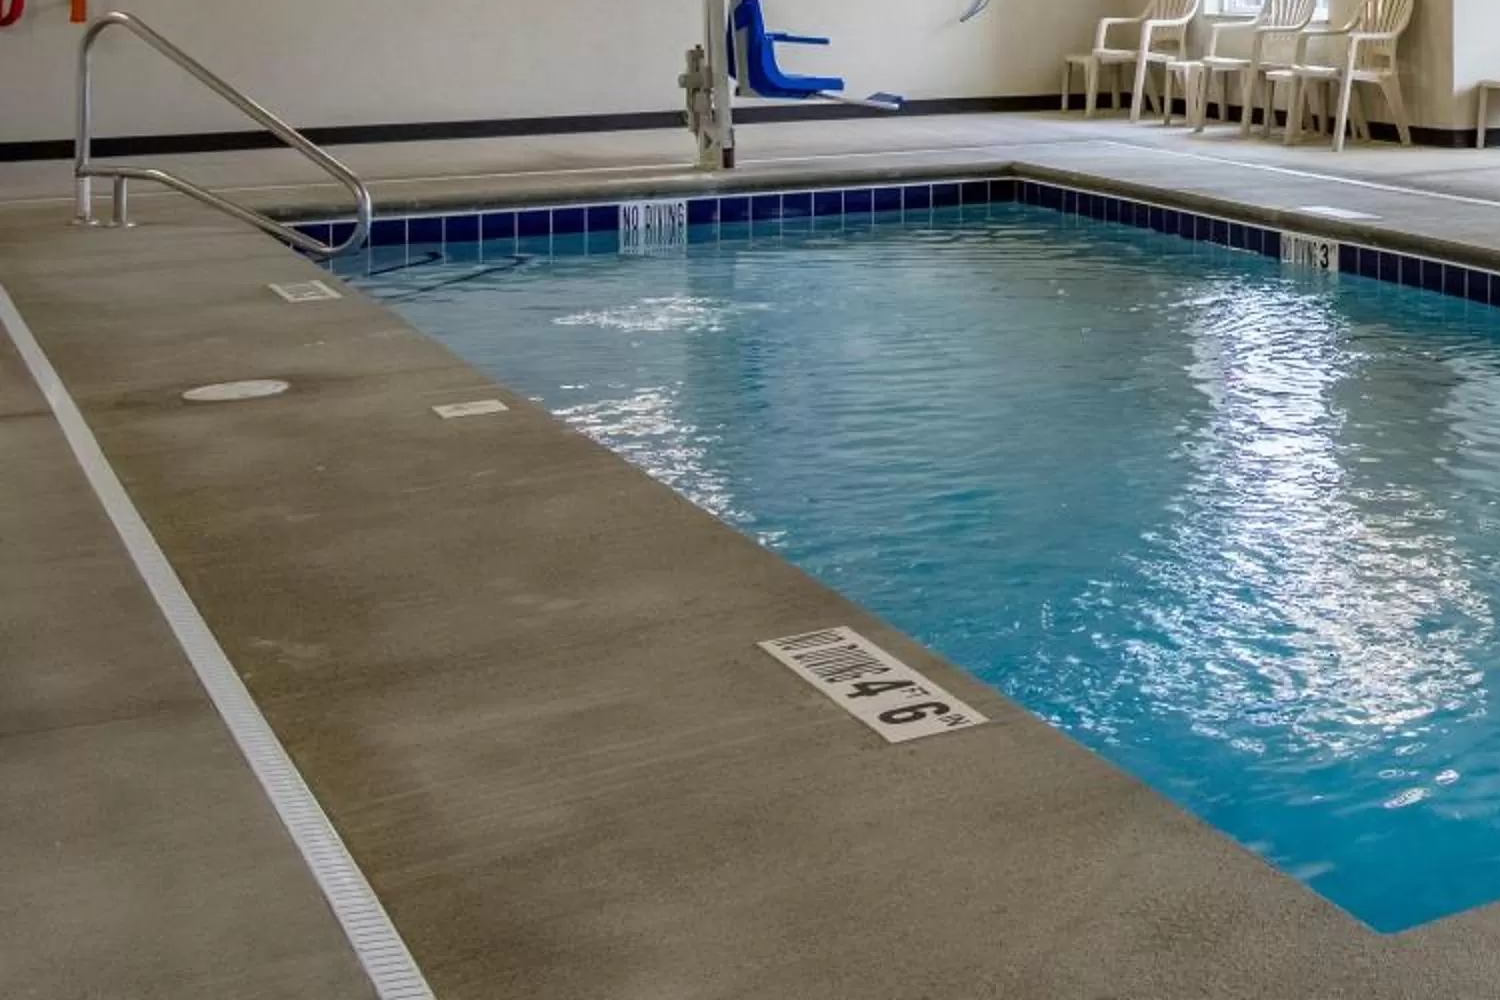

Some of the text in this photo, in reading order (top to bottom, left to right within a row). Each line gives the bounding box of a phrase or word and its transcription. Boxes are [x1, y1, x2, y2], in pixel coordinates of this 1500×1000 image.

[623, 206, 639, 230] NO
[1319, 243, 1329, 269] 3
[846, 680, 915, 698] 4
[878, 701, 950, 725] 6
